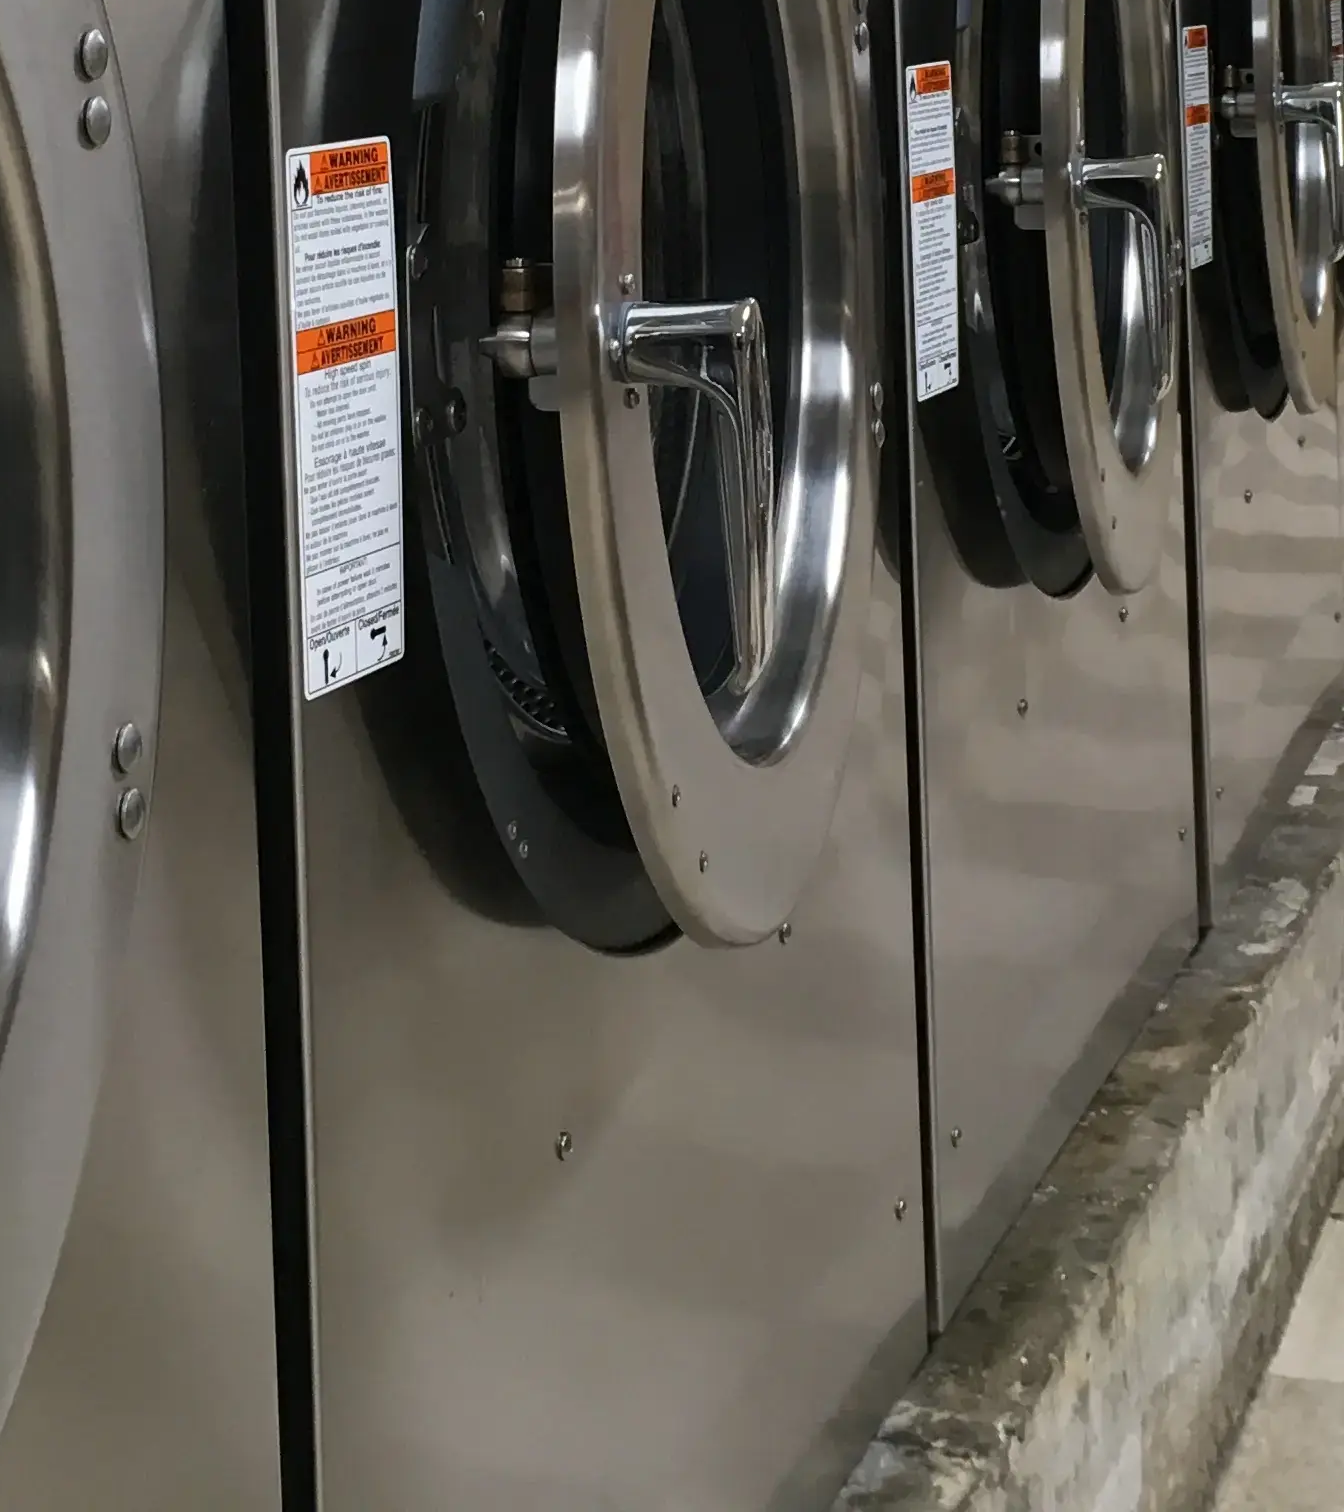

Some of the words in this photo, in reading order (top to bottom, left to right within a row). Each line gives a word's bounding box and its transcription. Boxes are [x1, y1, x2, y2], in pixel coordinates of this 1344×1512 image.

[329, 147, 378, 168] WARNING
[324, 166, 386, 190] AVERTISSEMENT
[326, 317, 376, 343] WARNING
[321, 336, 384, 366] AVERTISSEMENT
[324, 368, 339, 380] High
[340, 363, 358, 376] speed
